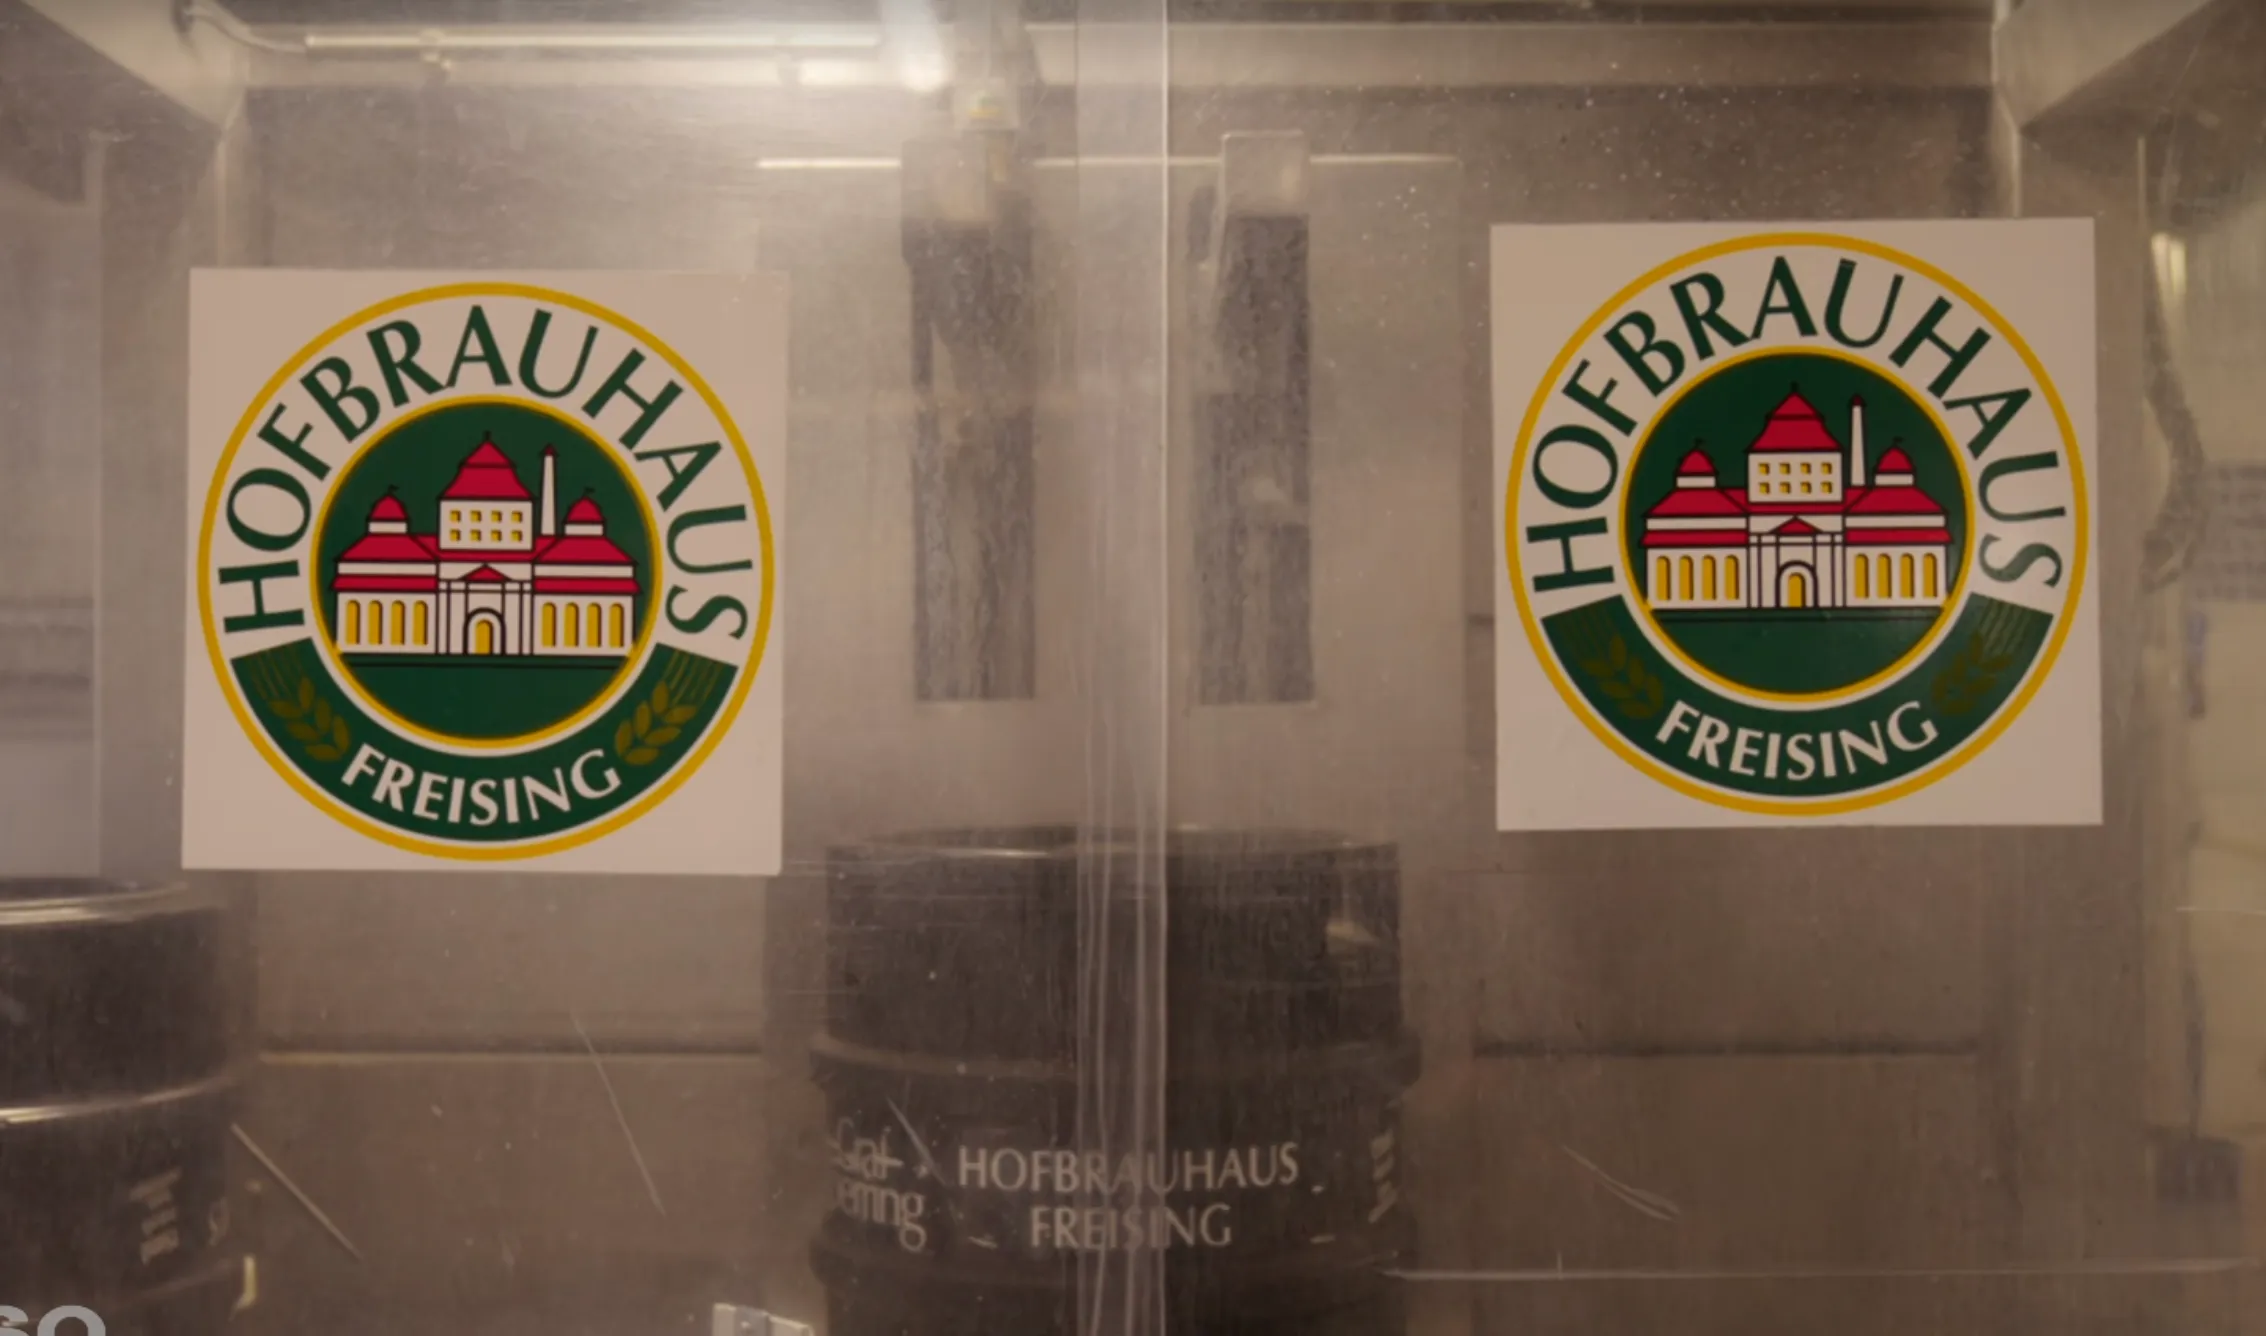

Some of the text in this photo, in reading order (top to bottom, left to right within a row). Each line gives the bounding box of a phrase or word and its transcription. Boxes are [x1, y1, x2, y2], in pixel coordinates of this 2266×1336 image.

[1526, 256, 2066, 593] HOFBRAUHAUS
[218, 304, 754, 634] HOFBRAUHAUS
[1655, 700, 1940, 781] FREISING
[340, 742, 622, 826] FREISING
[958, 1143, 1300, 1194] HOFBRAUHAUS
[1031, 1203, 1232, 1249] FREISING
